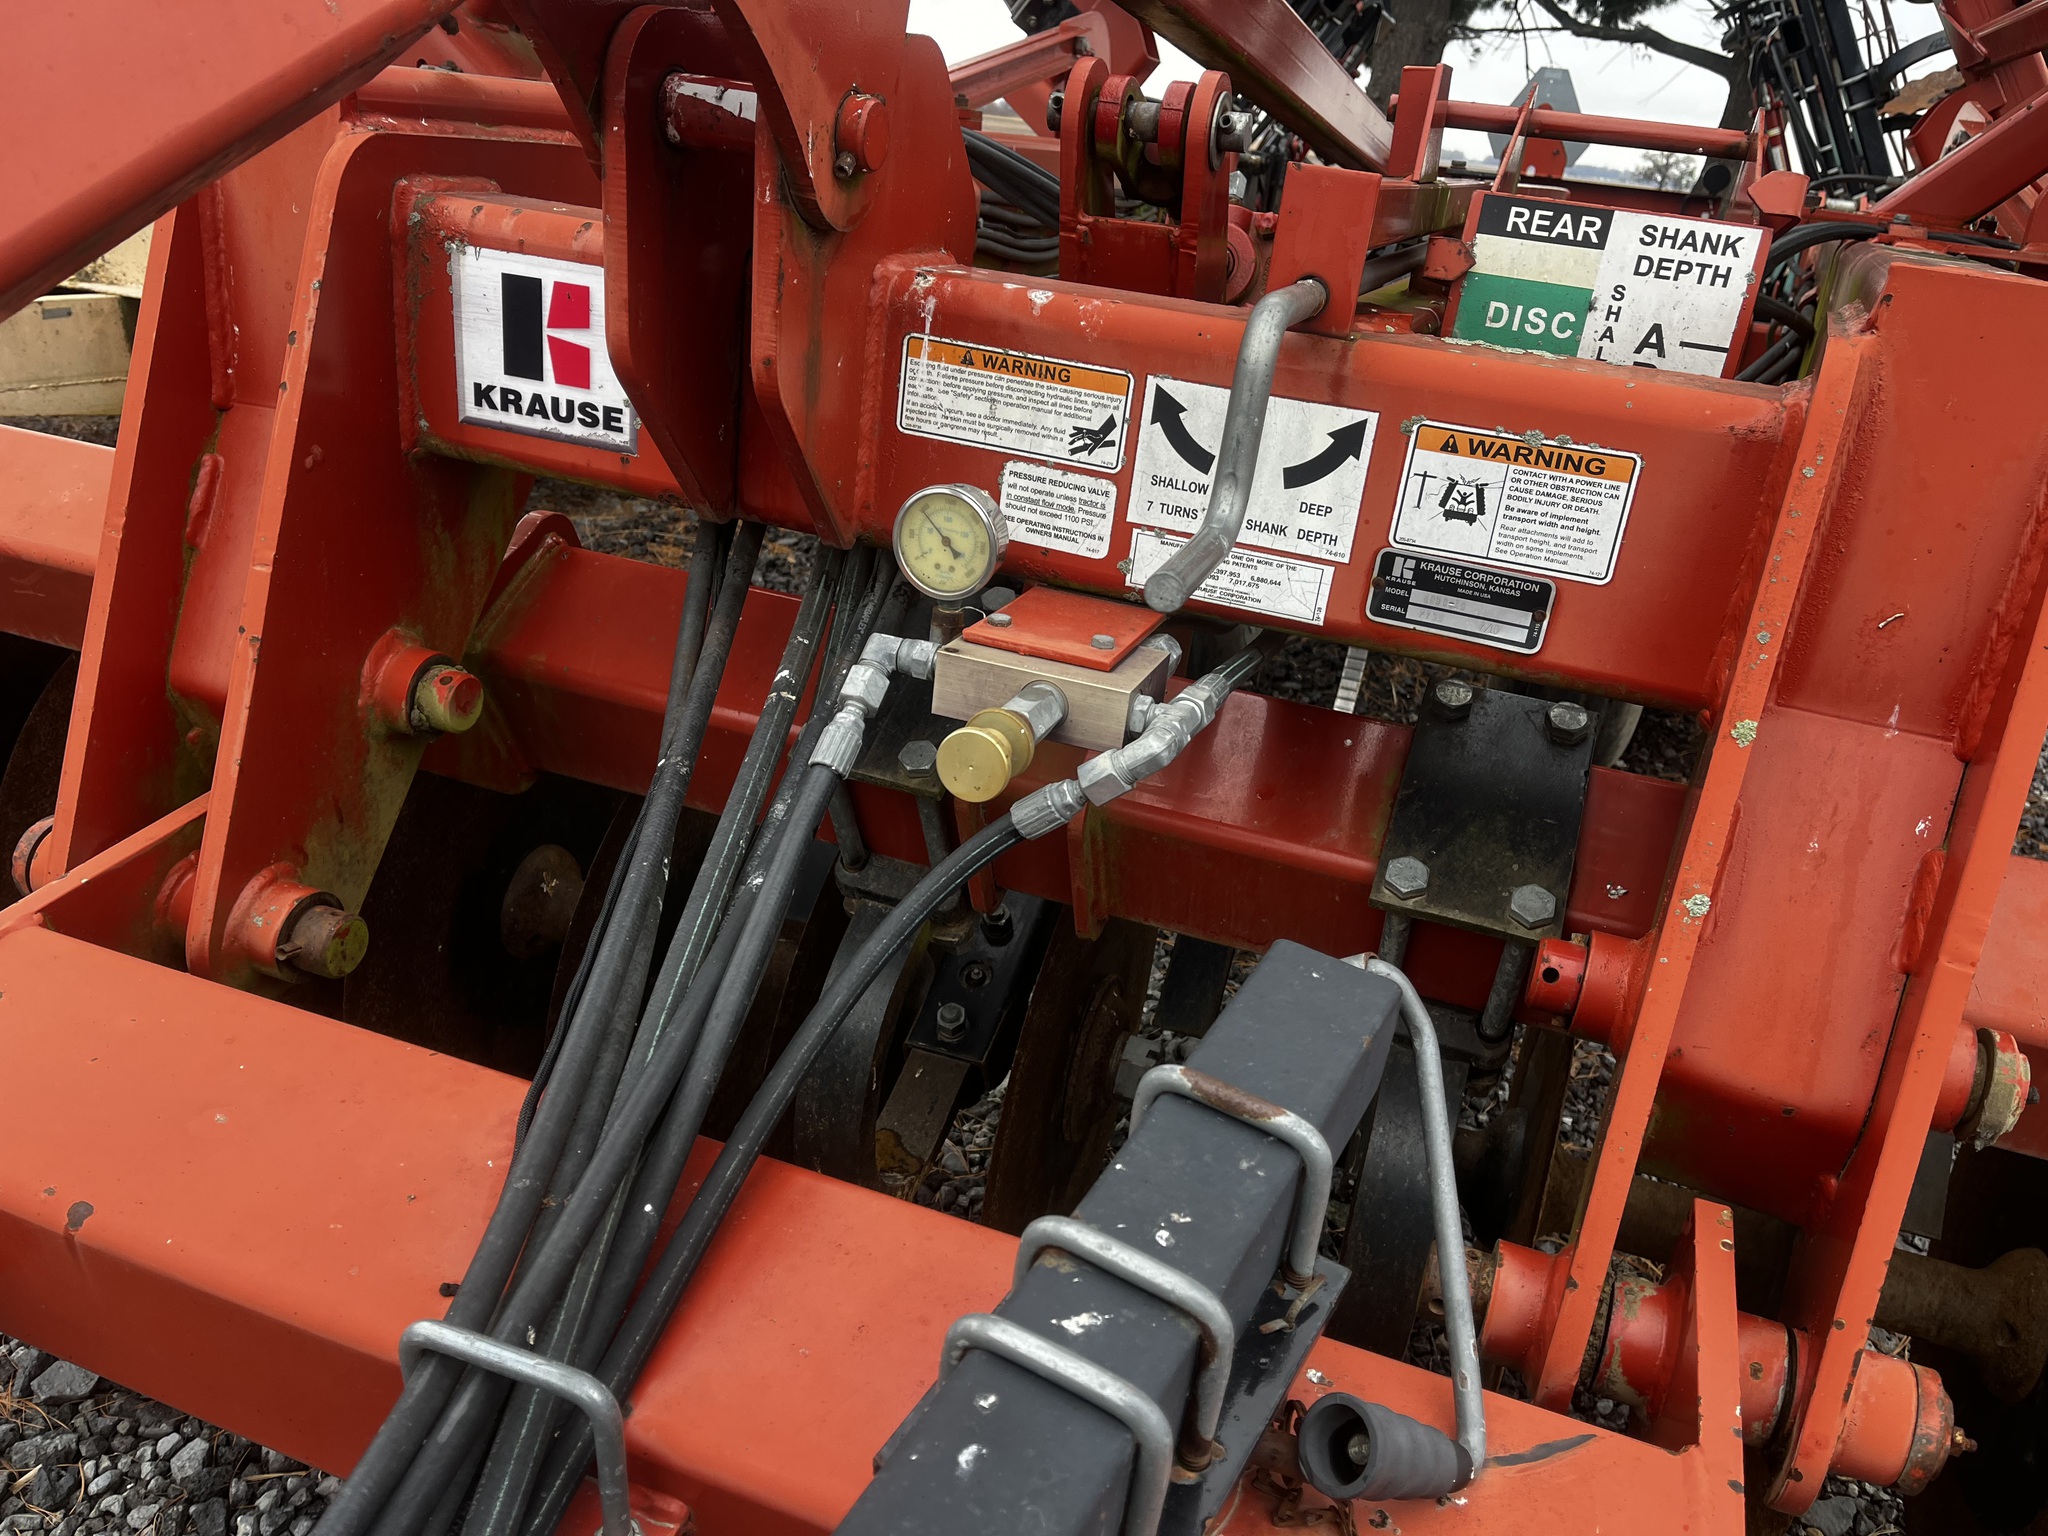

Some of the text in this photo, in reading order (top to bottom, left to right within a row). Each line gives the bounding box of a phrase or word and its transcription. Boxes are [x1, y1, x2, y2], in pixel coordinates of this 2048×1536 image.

[1506, 206, 1602, 244] REAR
[1639, 224, 1744, 258] SHANK
[1633, 254, 1732, 288] DEPTH
[1485, 300, 1576, 339] DISC
[982, 354, 1071, 383] WARNING
[473, 382, 623, 433] KRAUSE
[1469, 438, 1606, 475] WARNING
[1009, 470, 1110, 498] PRESSURE REDUCING VALVE
[1150, 475, 1209, 495] SHALLOW
[1513, 469, 1547, 479] CONTACT
[1549, 475, 1567, 483] WITH
[1575, 479, 1603, 488] POWER
[1523, 479, 1549, 489] OTHER
[1550, 484, 1603, 497] OBSTRUCTION
[1030, 488, 1055, 498] operate
[1056, 494, 1077, 503] unless
[1507, 494, 1533, 503] BODILY
[1534, 499, 1561, 508] INJURY
[1509, 486, 1534, 495] CAUSE
[1570, 496, 1603, 506] SERIOUS
[1005, 502, 1026, 512] should
[1039, 510, 1062, 520] exceed
[1065, 514, 1080, 524] 1100
[1014, 494, 1040, 505] constant
[1042, 499, 1055, 508] flow
[1078, 507, 1107, 519] Pressure
[1147, 501, 1198, 520] 7 TURNS
[1299, 502, 1333, 518] DEEP
[1503, 514, 1537, 525] transport
[1539, 520, 1558, 528] width
[1516, 508, 1538, 516] aware
[1550, 513, 1589, 525] implement
[1016, 518, 1051, 530] OPERATING
[1052, 525, 1096, 540] INSTRUCTIONS
[1026, 527, 1079, 544] OWNERS MANUAL
[1245, 519, 1338, 546] SHANK DEPTH
[1500, 524, 1517, 532] Rear
[1518, 528, 1558, 539] attachments
[1498, 532, 1528, 542] transport
[1568, 544, 1598, 554] transport
[1257, 559, 1273, 567] MORE
[1510, 550, 1542, 560] Operation
[1232, 561, 1257, 570] PATENTS
[1386, 576, 1416, 586] KRAUSE
[1420, 562, 1540, 592] KRAUSE CORPORATION
[1219, 591, 1261, 604] CORPORATION
[1385, 587, 1409, 597] MODEL
[1489, 585, 1521, 597] KANSAS
[1381, 604, 1405, 614] SERIAL
